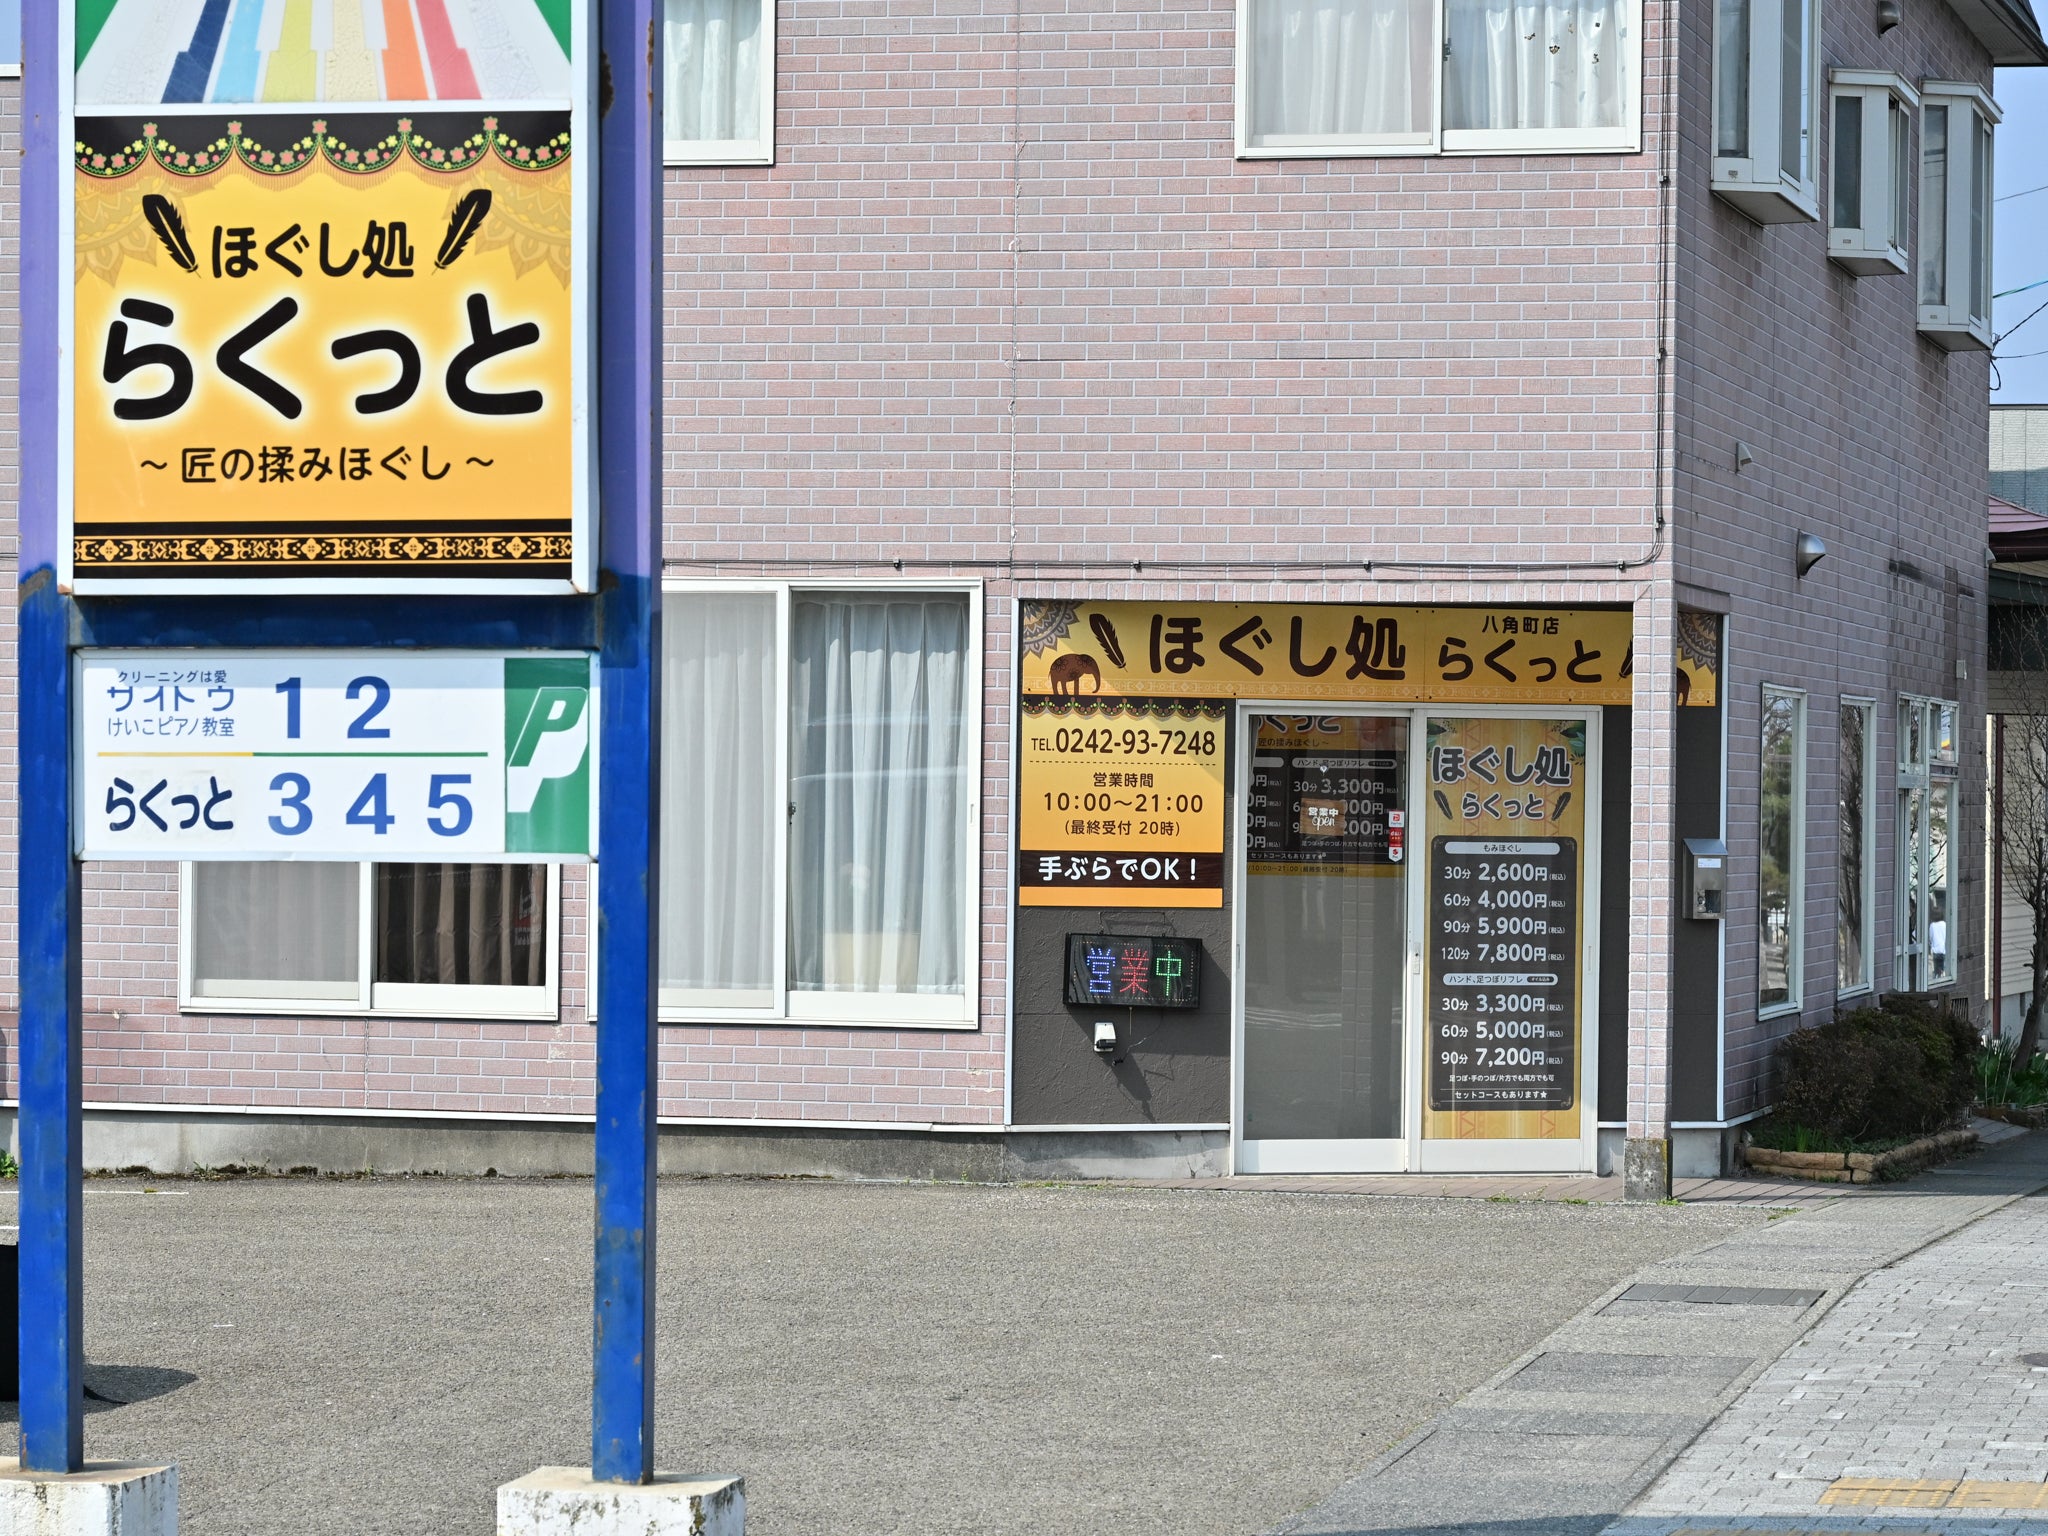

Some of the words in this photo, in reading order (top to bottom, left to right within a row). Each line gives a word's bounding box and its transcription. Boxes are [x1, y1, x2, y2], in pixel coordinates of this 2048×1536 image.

[212, 220, 414, 278] ほぐし処
[104, 293, 543, 420] らくっと
[1482, 615, 1559, 635] 八角町店
[1149, 614, 1406, 680] ほぐし処
[1438, 638, 1602, 683] らくっと
[118, 670, 227, 683] クリーニングは愛
[107, 686, 234, 712] サイトウ
[275, 676, 301, 739] 1
[345, 676, 391, 739] 2
[108, 716, 235, 738] けいこピアノ教室
[1432, 745, 1571, 785] ほぐし処
[1093, 772, 1154, 788] 営業時間
[105, 776, 234, 832] らくっと
[268, 772, 313, 836] 3
[346, 773, 395, 835] 4
[427, 774, 473, 837] 5
[1044, 792, 1203, 813] 10:00～21:00
[1462, 792, 1544, 818] らくっと
[1483, 844, 1522, 853] もみほぐし
[1444, 866, 1472, 879] 30分
[1443, 893, 1471, 906] 60分
[1443, 920, 1471, 933] 90分
[1441, 947, 1470, 960] 120分
[1087, 947, 1182, 996] 営業中
[1441, 998, 1469, 1012] 30分
[1441, 1024, 1469, 1038] 60分
[1441, 1051, 1469, 1065] 90分
